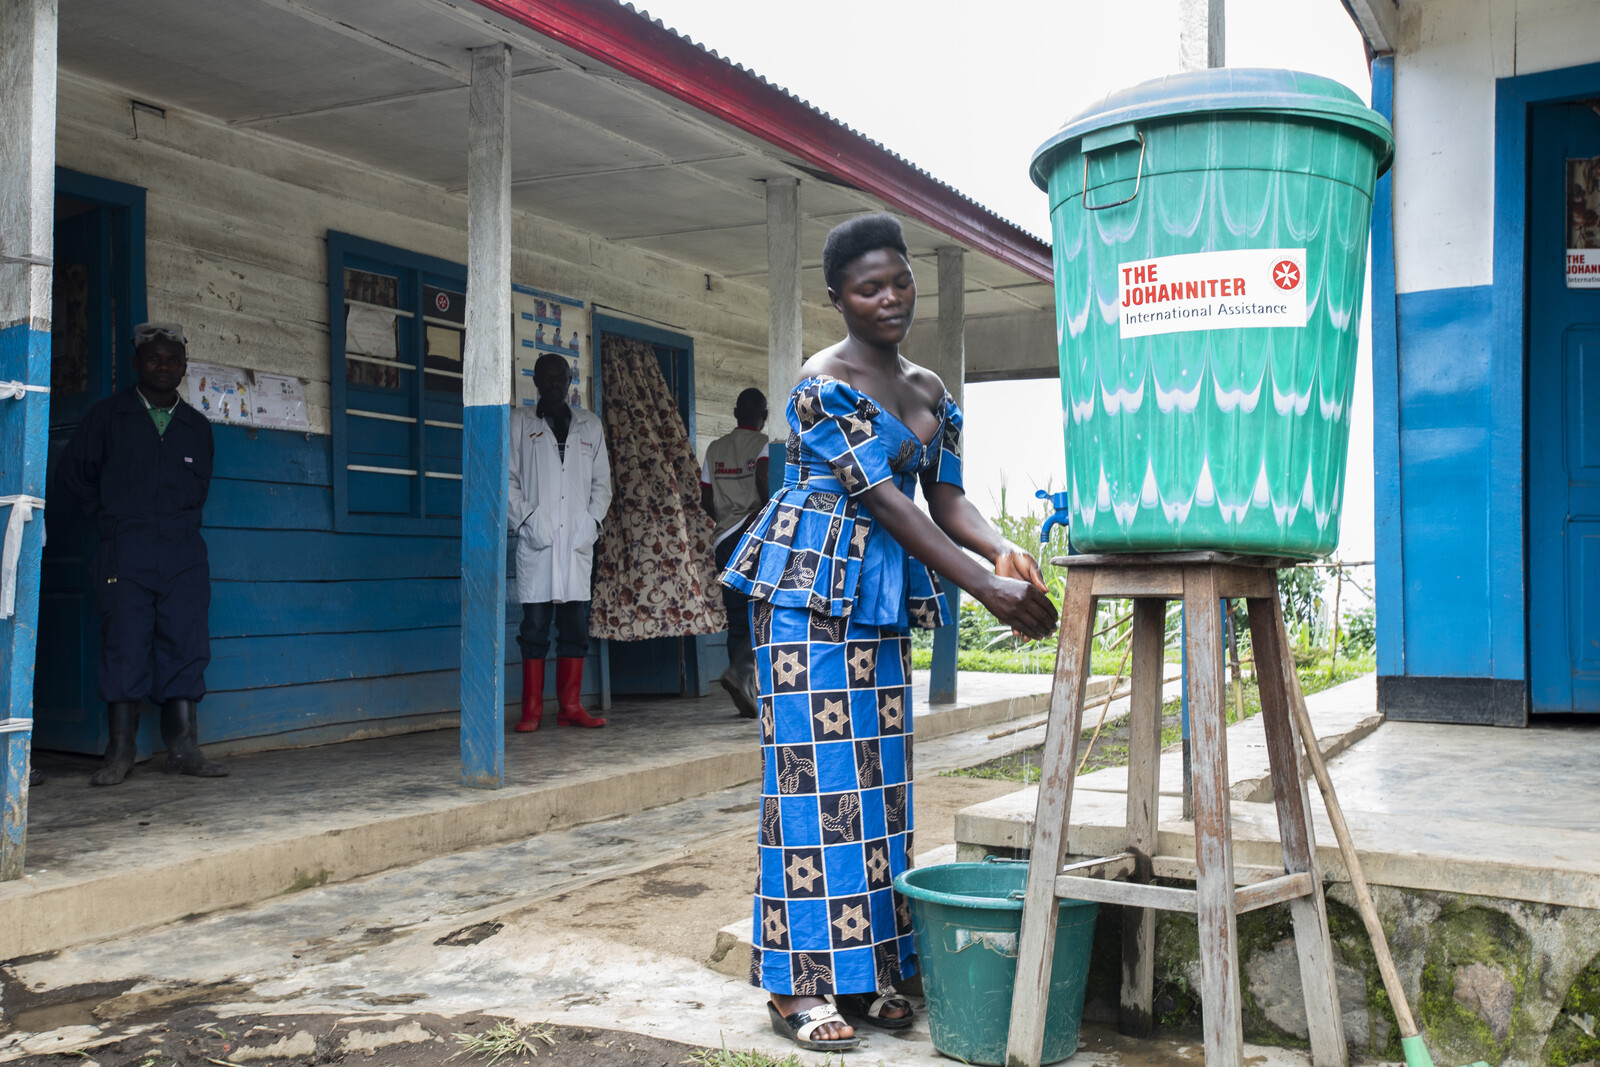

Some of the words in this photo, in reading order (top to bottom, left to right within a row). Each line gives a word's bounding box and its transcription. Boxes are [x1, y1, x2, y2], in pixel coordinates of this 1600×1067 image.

[1566, 254, 1585, 264] THE
[1566, 264, 1600, 275] JOHAN
[1122, 264, 1158, 286] THE
[1122, 278, 1246, 307] JOHANNITER
[1126, 305, 1212, 325] International
[1218, 302, 1288, 316] Assistance
